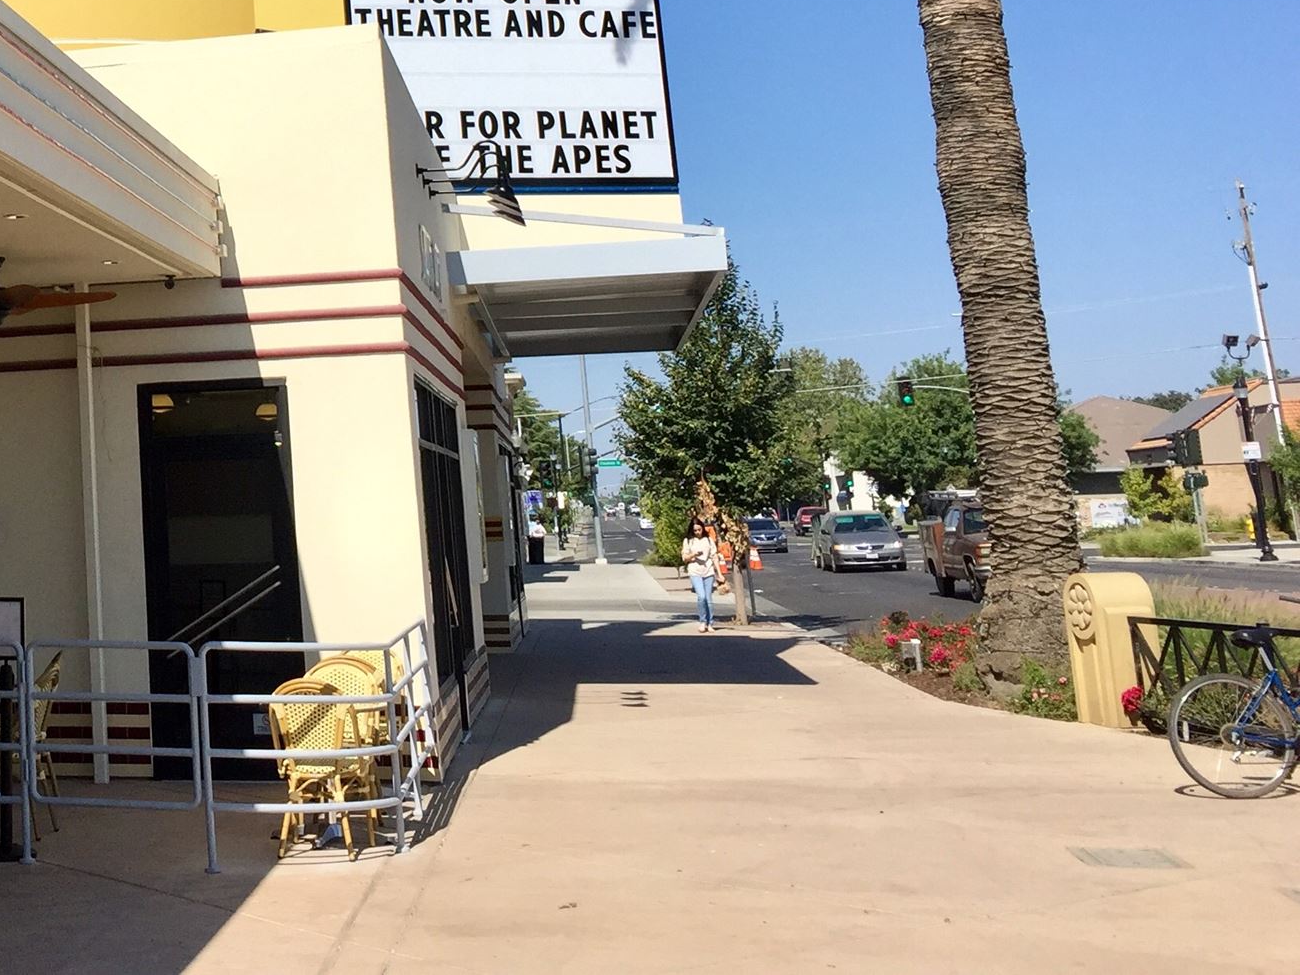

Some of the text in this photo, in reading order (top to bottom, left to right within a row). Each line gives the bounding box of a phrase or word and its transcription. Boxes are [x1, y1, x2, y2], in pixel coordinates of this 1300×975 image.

[354, 8, 657, 39] THEATRE AND CAFE
[460, 110, 523, 139] FOR
[536, 110, 657, 139] PLANET
[551, 144, 632, 174] APES
